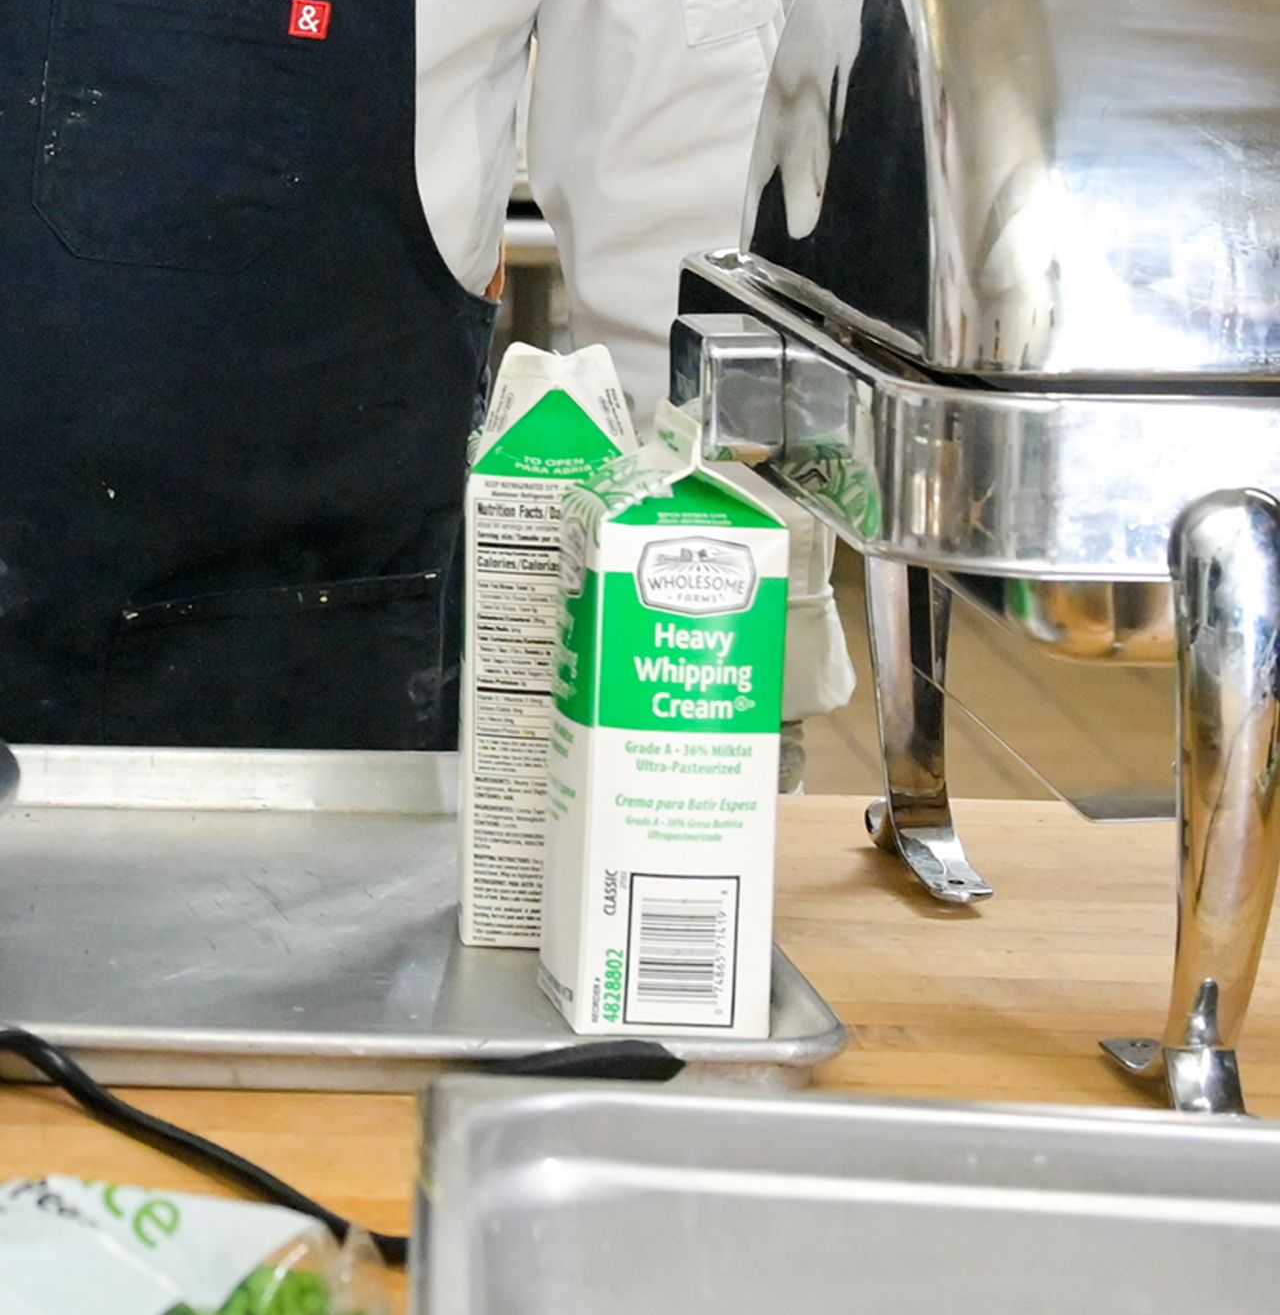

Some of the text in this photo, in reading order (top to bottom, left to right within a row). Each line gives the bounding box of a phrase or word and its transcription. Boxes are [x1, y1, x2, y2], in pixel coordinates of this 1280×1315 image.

[297, 4, 321, 34] &
[544, 457, 585, 467] OPEN
[477, 502, 516, 517] Nutrition
[646, 574, 746, 595] WHOLESOME
[654, 621, 735, 658] Heavy
[633, 655, 753, 693] Whipping
[624, 740, 661, 755] Grade
[663, 743, 673, 756] A
[683, 744, 709, 757] 36%
[711, 744, 753, 758] Milkfat
[635, 758, 742, 775] Ultra-Pasteurized
[614, 793, 758, 813] Crema para Batir Espesa
[602, 869, 618, 917] CLASSIC
[602, 947, 624, 1024] 4828802
